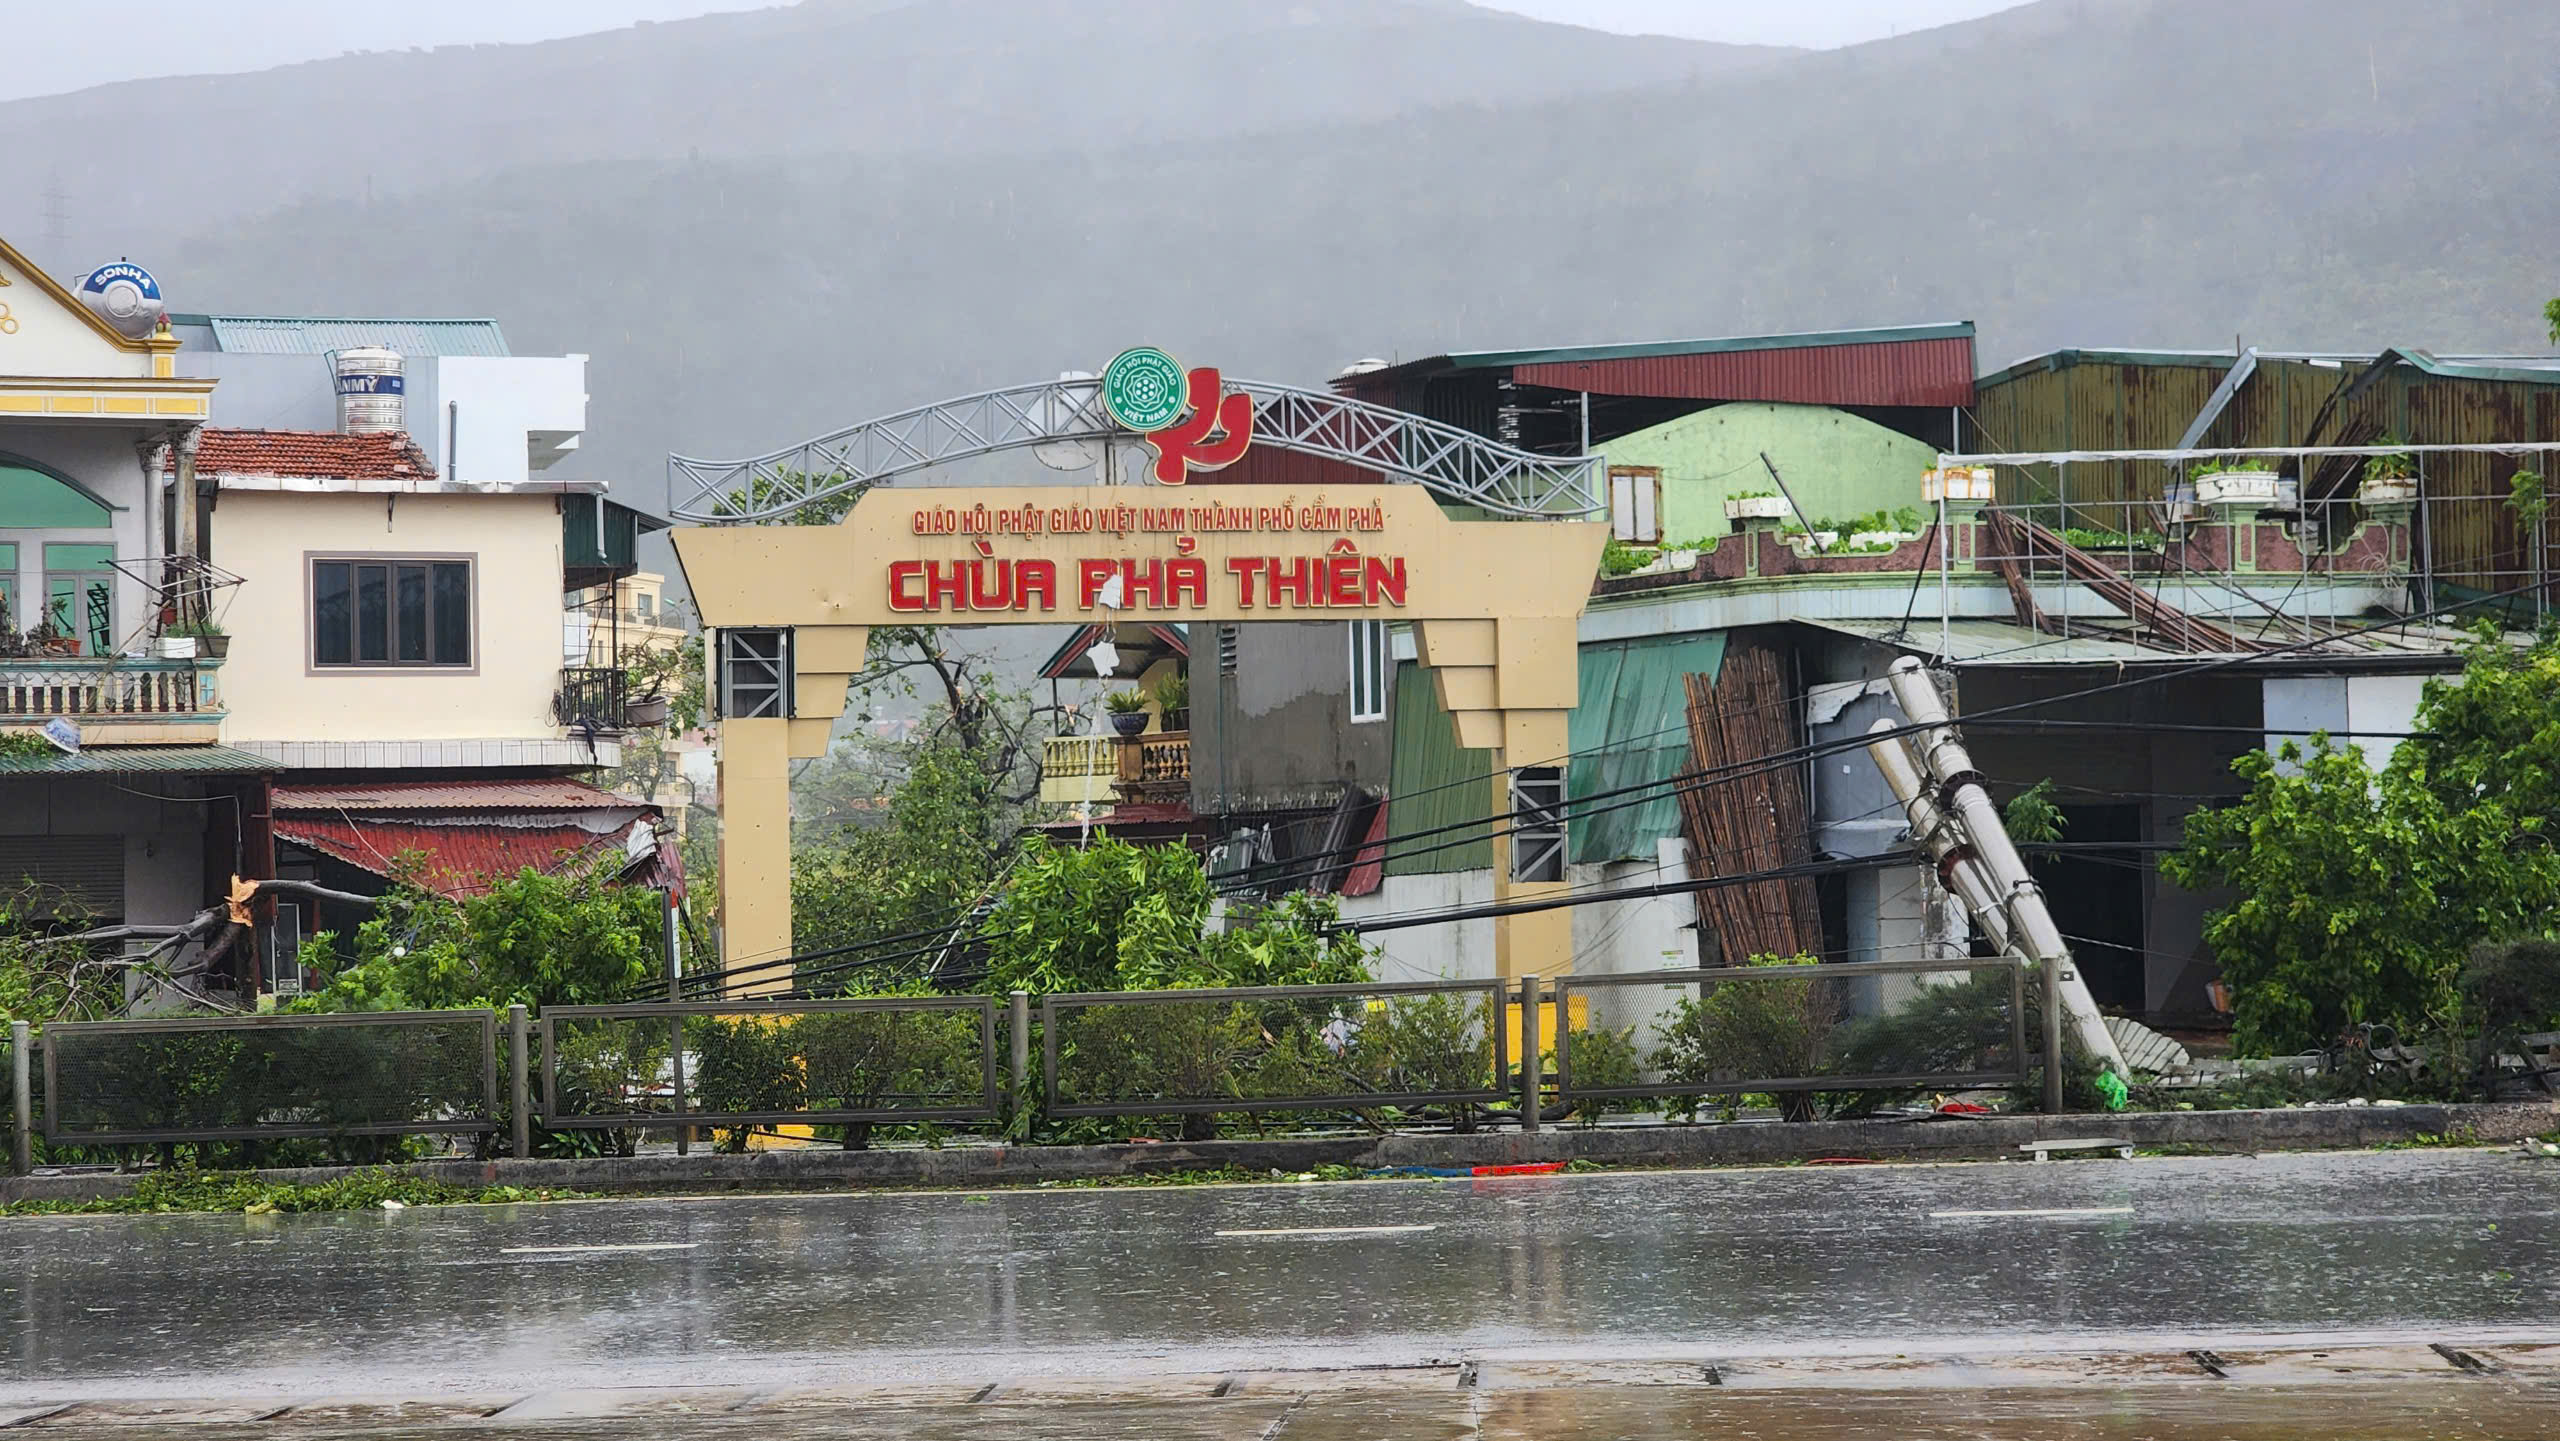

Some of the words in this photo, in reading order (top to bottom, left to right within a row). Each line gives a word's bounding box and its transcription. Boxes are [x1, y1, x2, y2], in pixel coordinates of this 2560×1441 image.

[95, 266, 151, 290] SONHA
[1146, 407, 1168, 422] NAM
[913, 503, 957, 535] GIÁO
[961, 502, 994, 541] HỘI
[997, 502, 1045, 540] PHẬT
[1049, 501, 1094, 534] GIÁO
[1097, 501, 1138, 540] VIỆT
[1142, 506, 1186, 533] NAM
[1190, 499, 1253, 532] THÀNH
[1299, 494, 1342, 532] CẨM
[1346, 497, 1385, 532] PHẢ
[888, 540, 1057, 612] CHÙA
[1078, 536, 1208, 610] PHẢ
[1226, 537, 1407, 609] THIÊN
